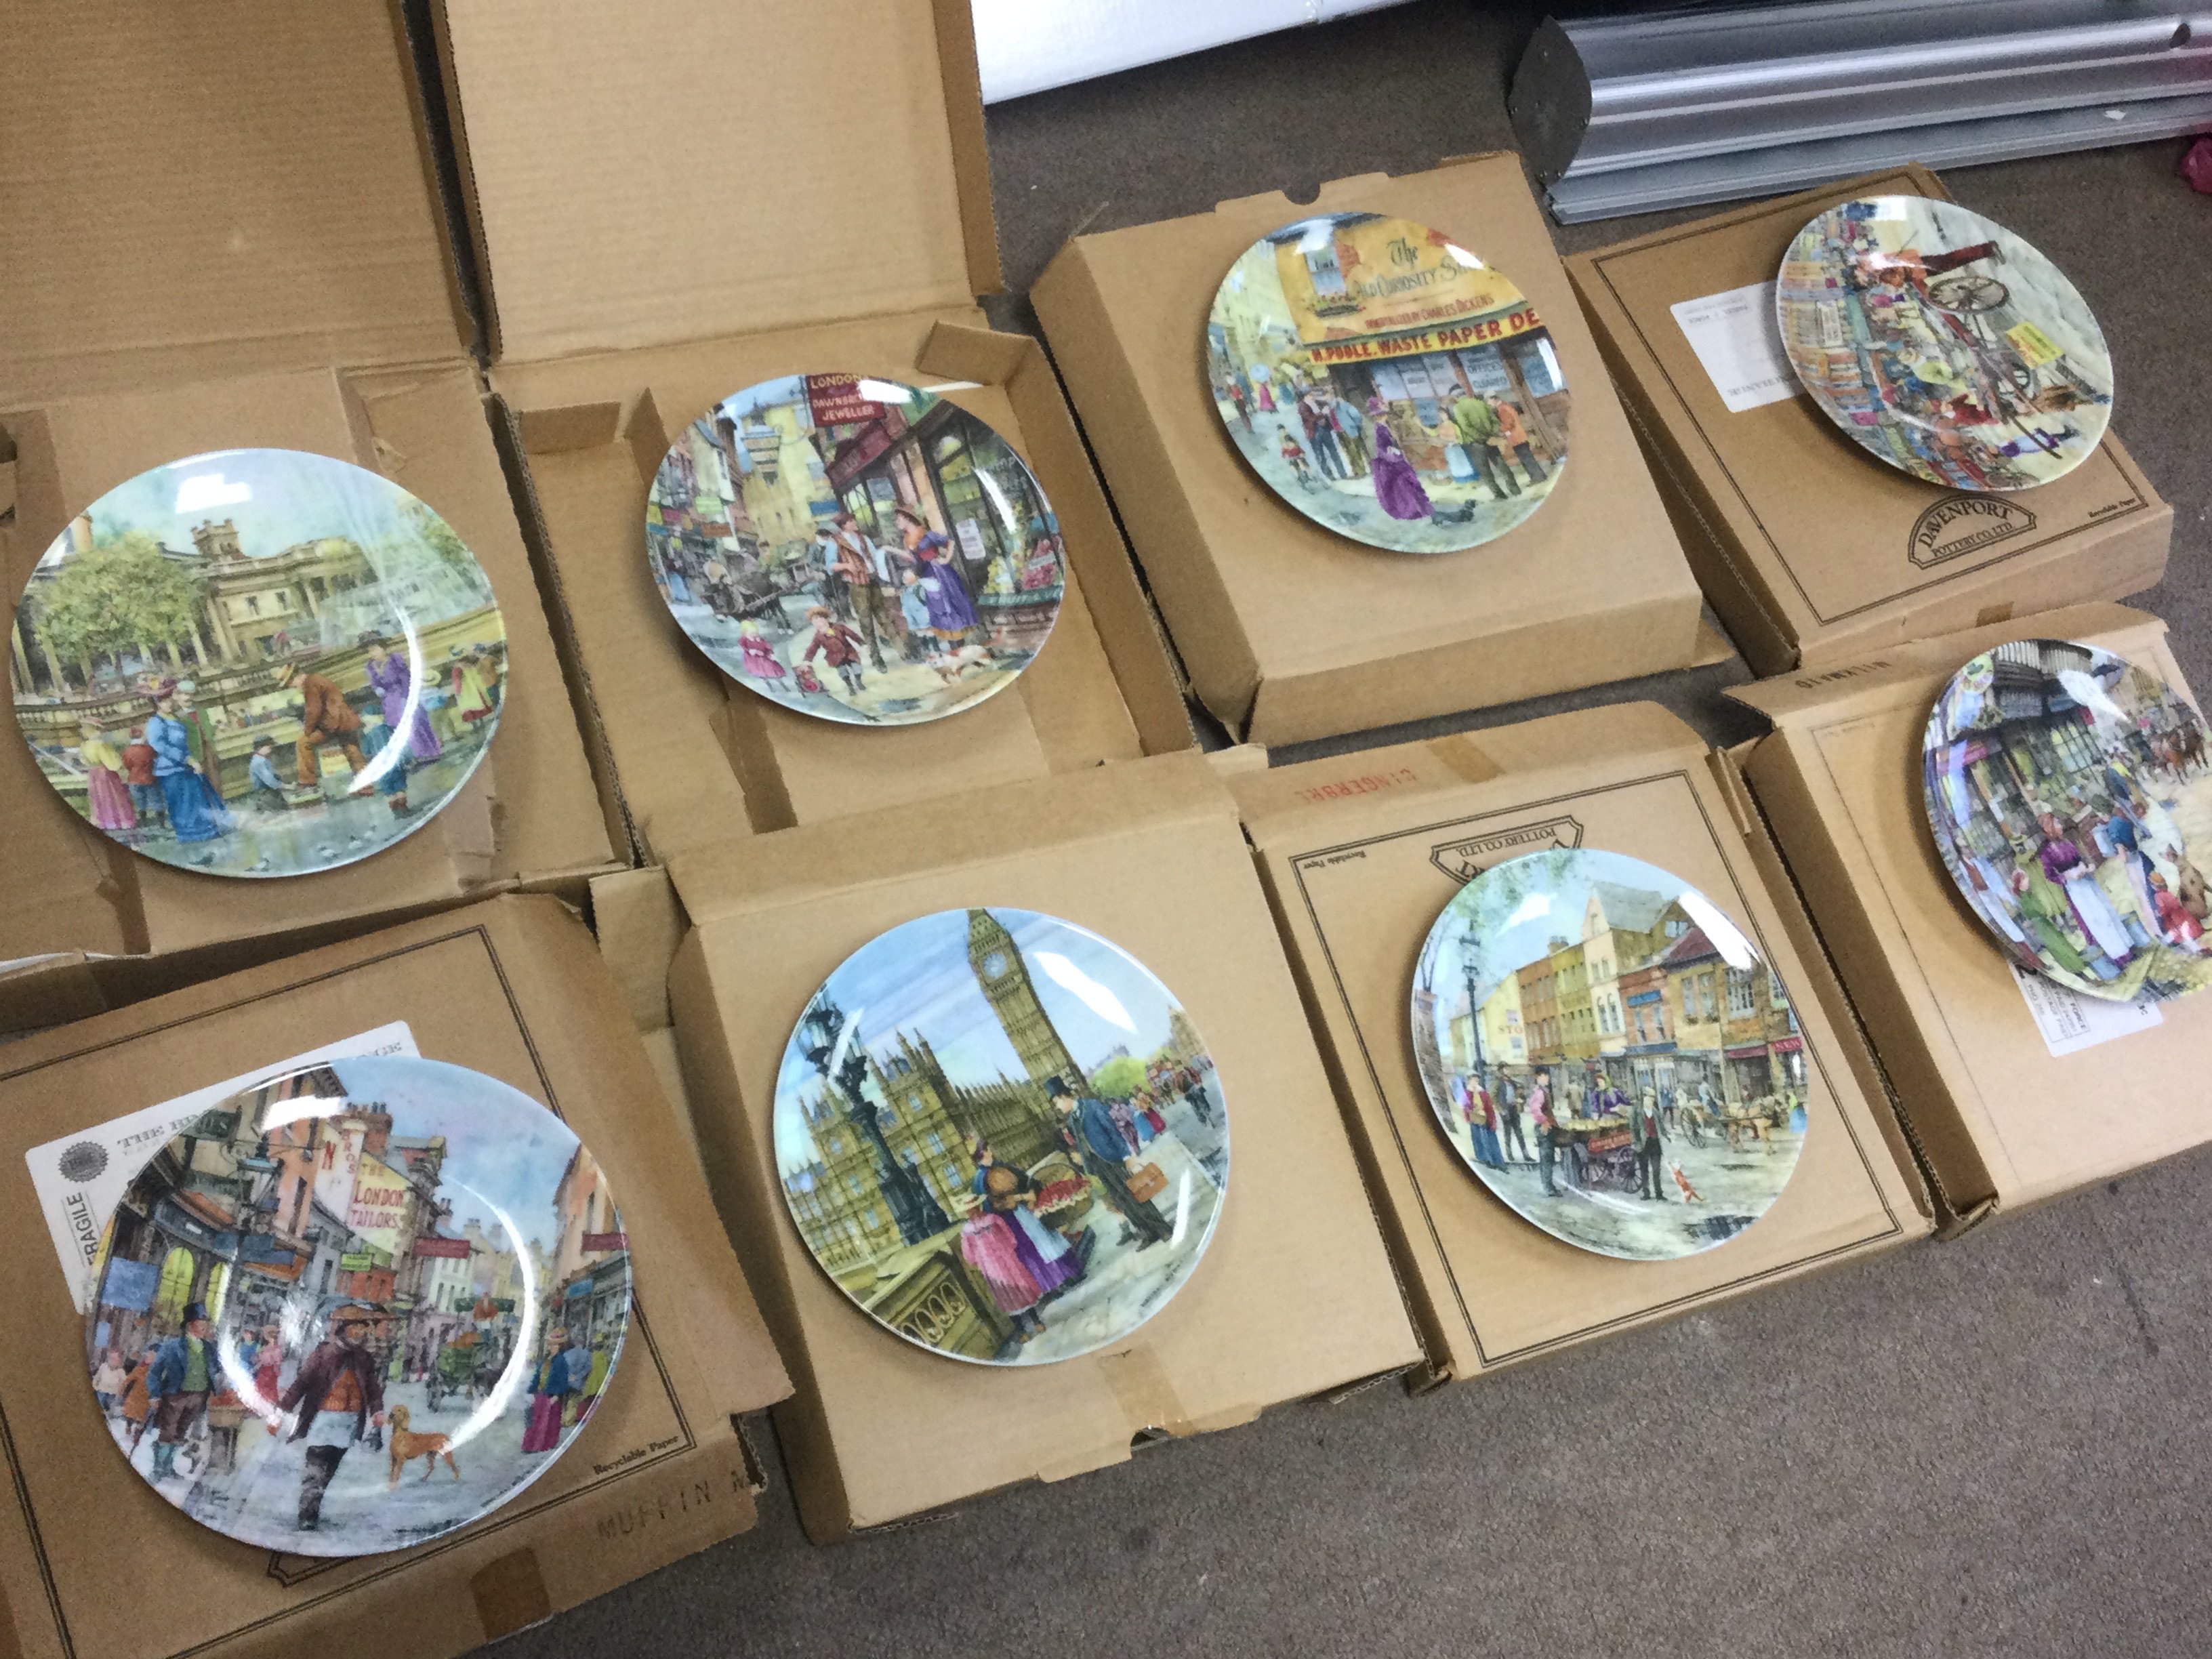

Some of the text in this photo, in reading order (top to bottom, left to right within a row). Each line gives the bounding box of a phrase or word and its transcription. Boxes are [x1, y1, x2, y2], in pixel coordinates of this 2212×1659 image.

[1377, 333, 1433, 355] WASTE
[1437, 319, 1503, 348] PAPER
[810, 374, 861, 389] LONDON
[1918, 498, 2015, 548] DAVENPORT
[1931, 533, 1977, 558] POTTERY
[1504, 827, 1557, 847] POTTERY
[1774, 1040, 1801, 1050] NEW
[117, 1125, 165, 1148] THE
[353, 1181, 405, 1207] LONDON
[592, 1435, 679, 1475] Recyclable Paper
